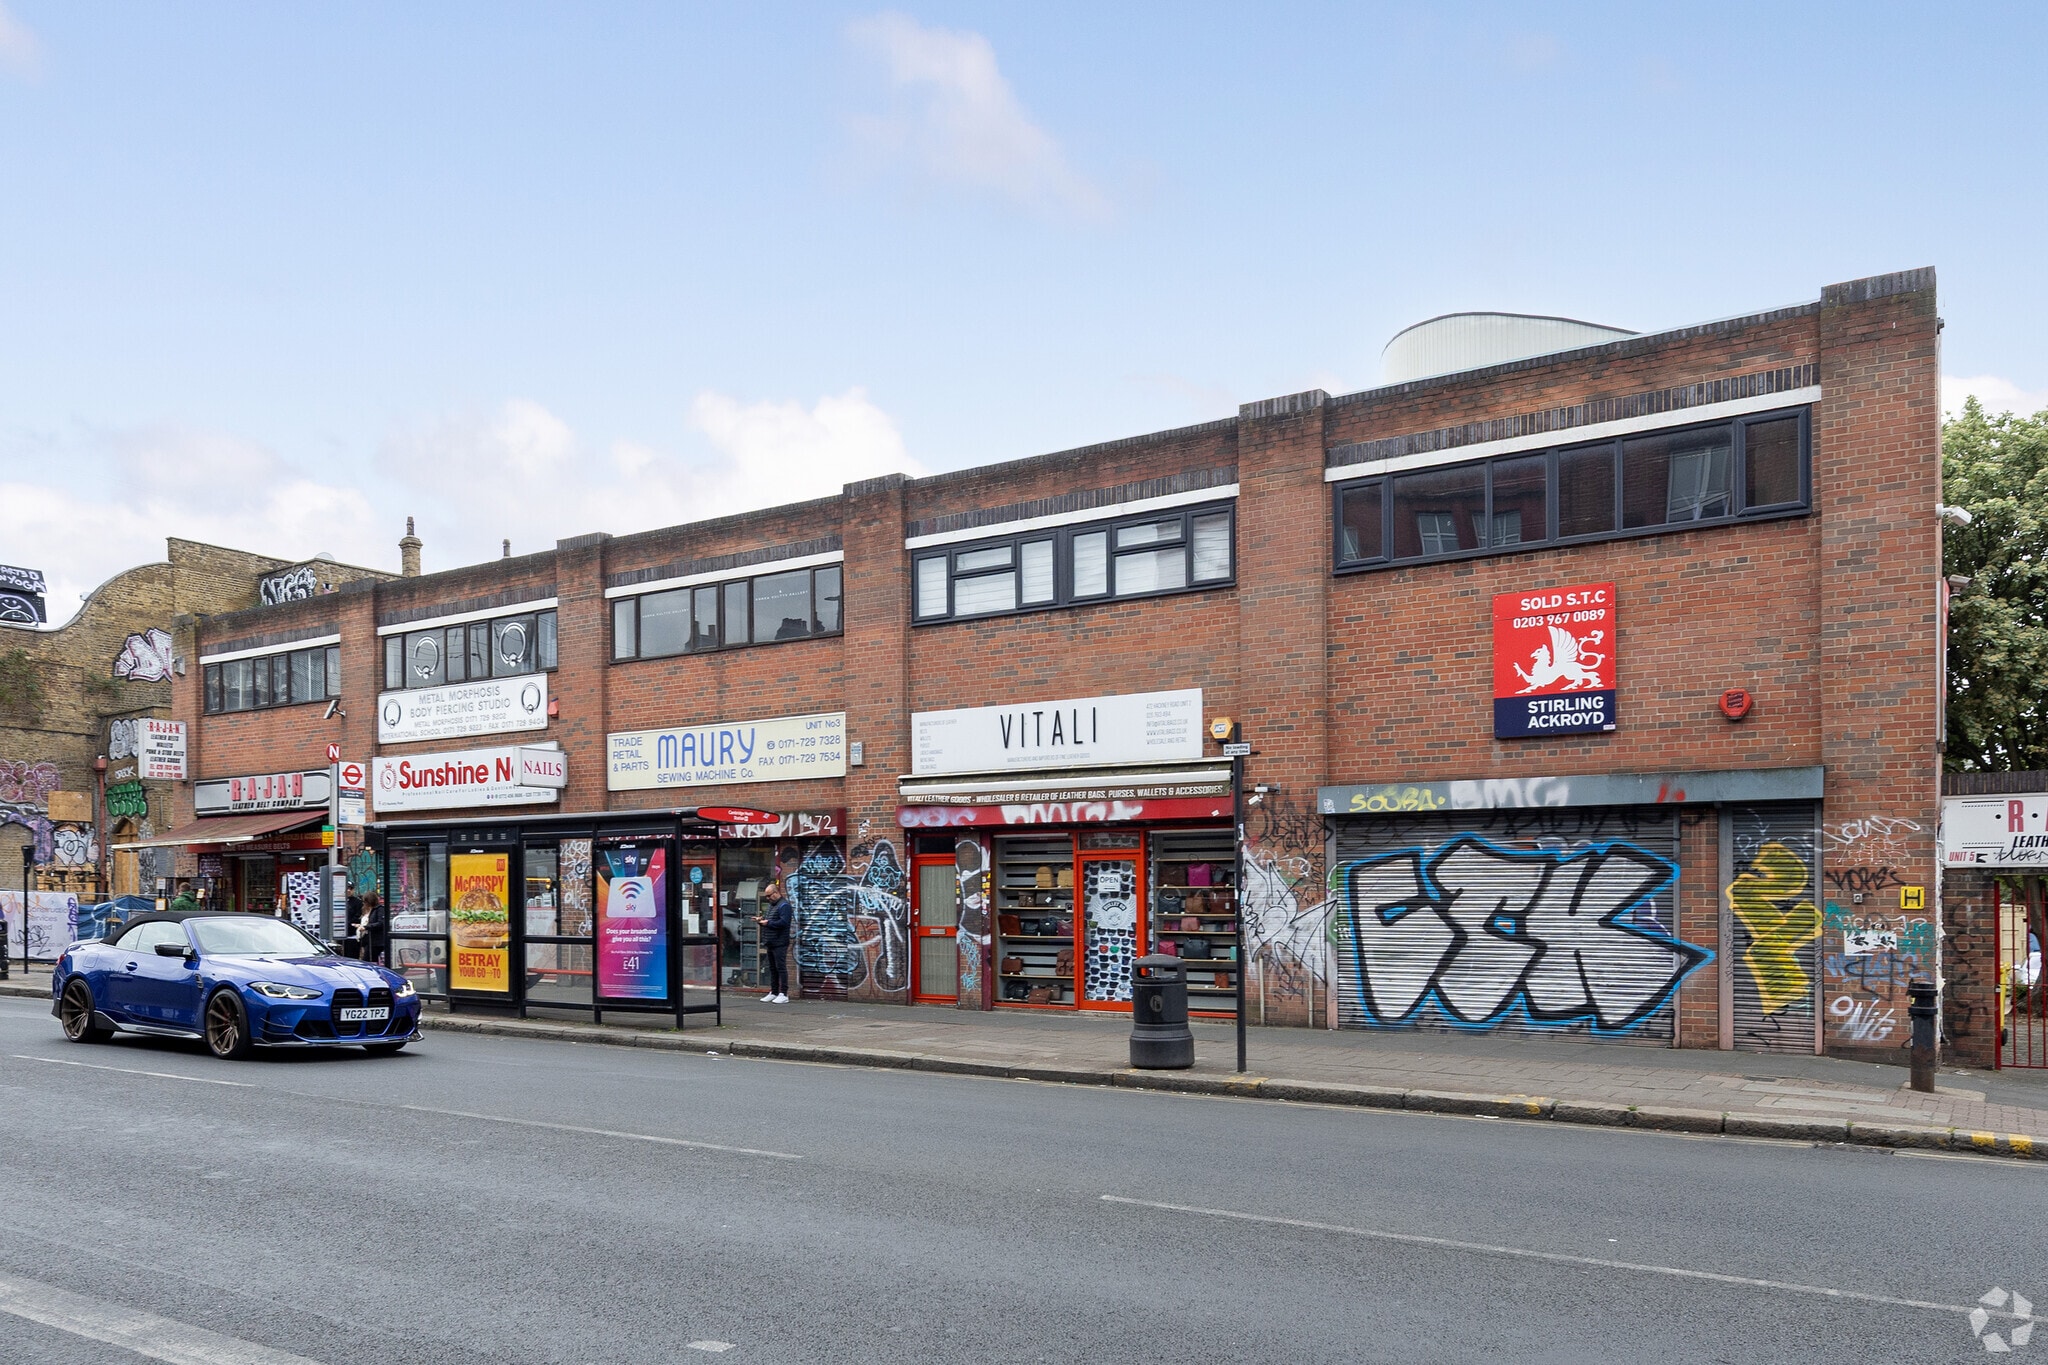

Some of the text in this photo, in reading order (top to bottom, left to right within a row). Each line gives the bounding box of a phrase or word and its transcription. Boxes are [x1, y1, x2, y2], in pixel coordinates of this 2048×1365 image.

[1520, 590, 1606, 611] SOLD S.T.C
[1513, 608, 1606, 629] 0203 967 0089
[418, 686, 500, 704] METAL MORPHOSIS
[410, 698, 510, 718] BODY PIERCING STUDIO
[1528, 696, 1604, 714] STIRLING
[806, 720, 822, 730] UNIT
[1000, 706, 1096, 748] VITALI
[1528, 712, 1605, 729] ACKROYD
[613, 736, 643, 748] TRADE
[819, 735, 841, 746] 7328
[328, 745, 340, 758] N
[613, 750, 642, 760] RETAIL
[657, 728, 756, 769] MAURY
[613, 760, 650, 772] & PARTS
[758, 756, 775, 766] FAX
[819, 752, 841, 762] 7534
[399, 760, 489, 789] Sunshine
[524, 760, 562, 777] NAILS
[656, 772, 692, 784] SEWING
[696, 768, 736, 780] MACHINE
[925, 795, 950, 803] LEATHER
[950, 796, 972, 804] GOODS
[976, 794, 1014, 803] WHOLESALER
[1014, 793, 1020, 802] &
[1020, 792, 1050, 801] RETAILER
[1059, 790, 1086, 800] LEATHER
[1137, 786, 1168, 797] WALLETS
[1168, 786, 1174, 796] &
[1176, 785, 1224, 796] ACCESSORIES
[232, 798, 301, 810] LEATHER BELT COMPANY
[246, 843, 272, 851] MEASURE
[624, 855, 636, 864] sky
[1949, 852, 1975, 862] UNIT 5
[454, 876, 505, 892] McCRISPY
[1100, 876, 1119, 884] OPEN
[625, 903, 637, 912] sky
[458, 953, 501, 967] BETRAY
[623, 956, 639, 970] £41
[459, 966, 501, 978] YOUR GO TO
[345, 1008, 386, 1019] YG22 TPZ
